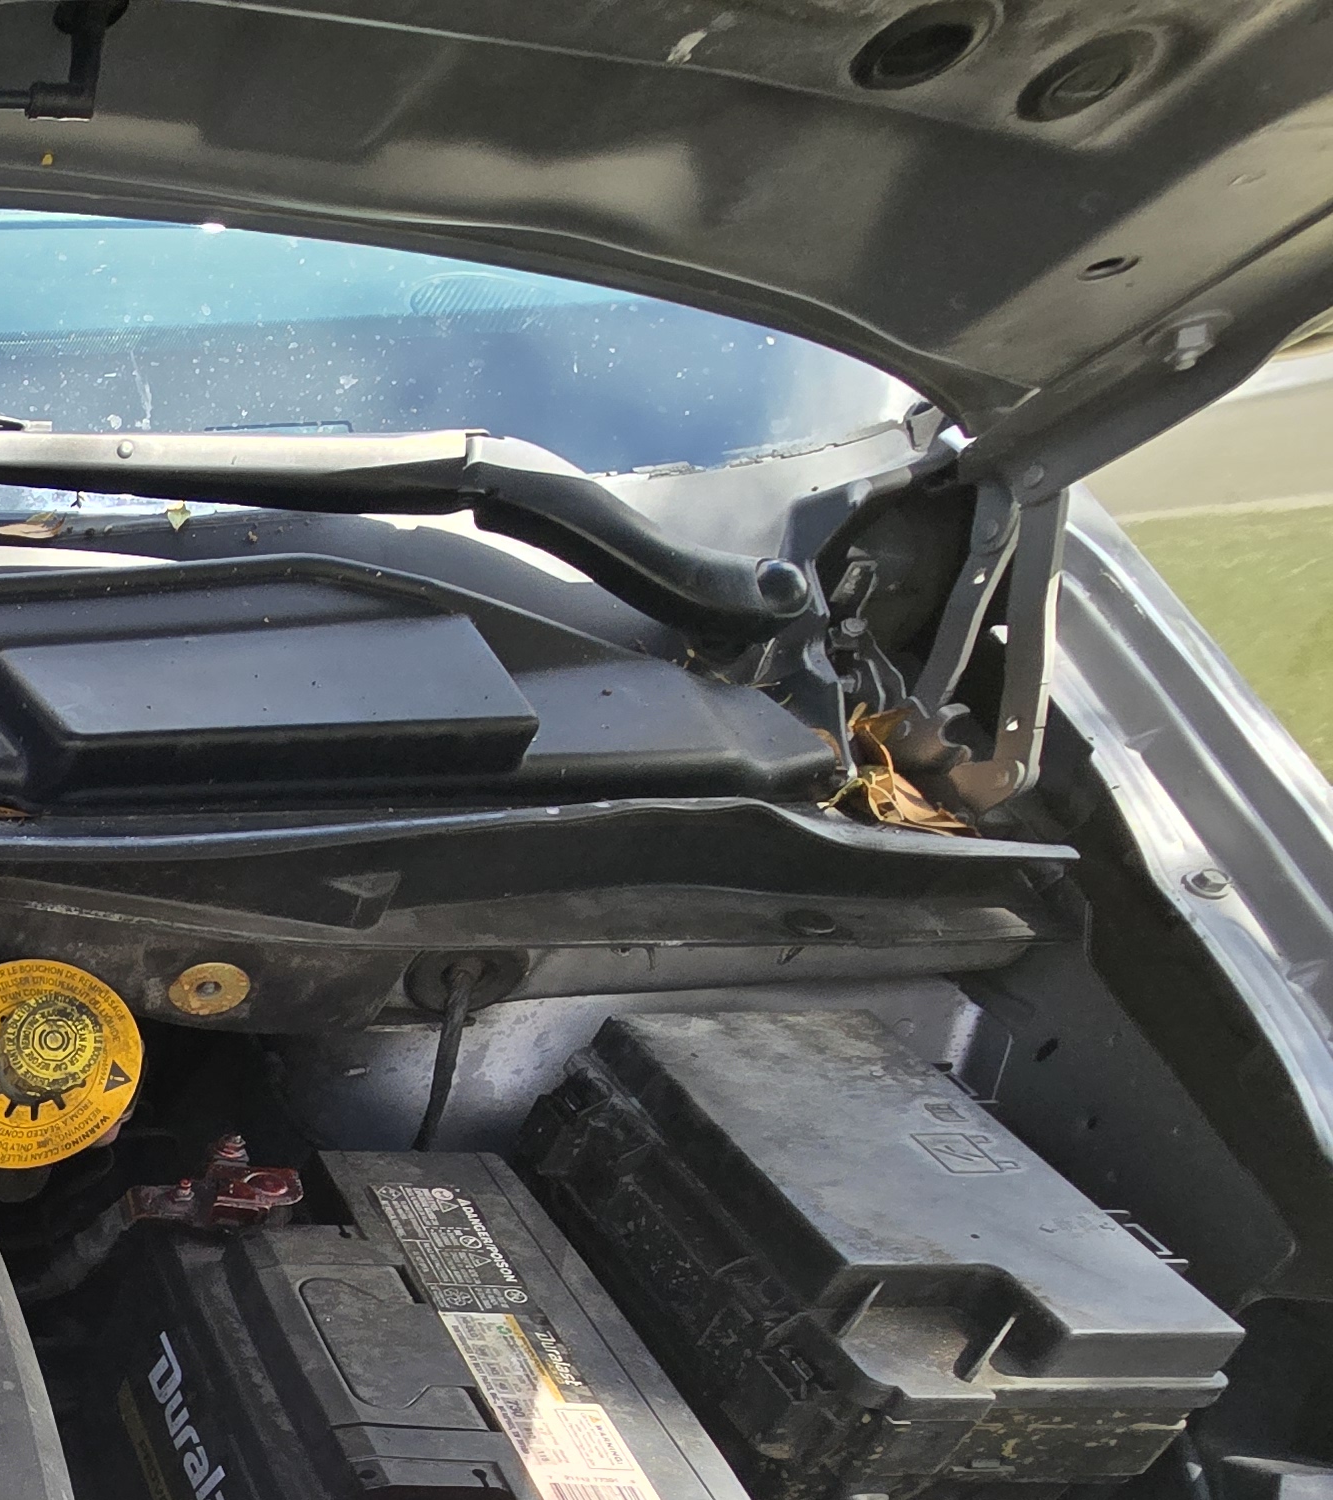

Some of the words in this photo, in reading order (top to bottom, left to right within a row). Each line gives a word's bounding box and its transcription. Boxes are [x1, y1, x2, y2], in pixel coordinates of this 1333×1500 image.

[8, 966, 19, 976] LE
[20, 964, 64, 977] BOUCHON
[65, 970, 77, 981] DE
[10, 1142, 33, 1152] ONLY
[33, 1148, 60, 1161] CLEAN
[1, 1153, 29, 1164] FILLER
[462, 1206, 518, 1283] DANGER/POISON
[534, 1330, 582, 1387] Duralast
[505, 1400, 526, 1418] 730
[595, 1425, 623, 1465] WARNING!
